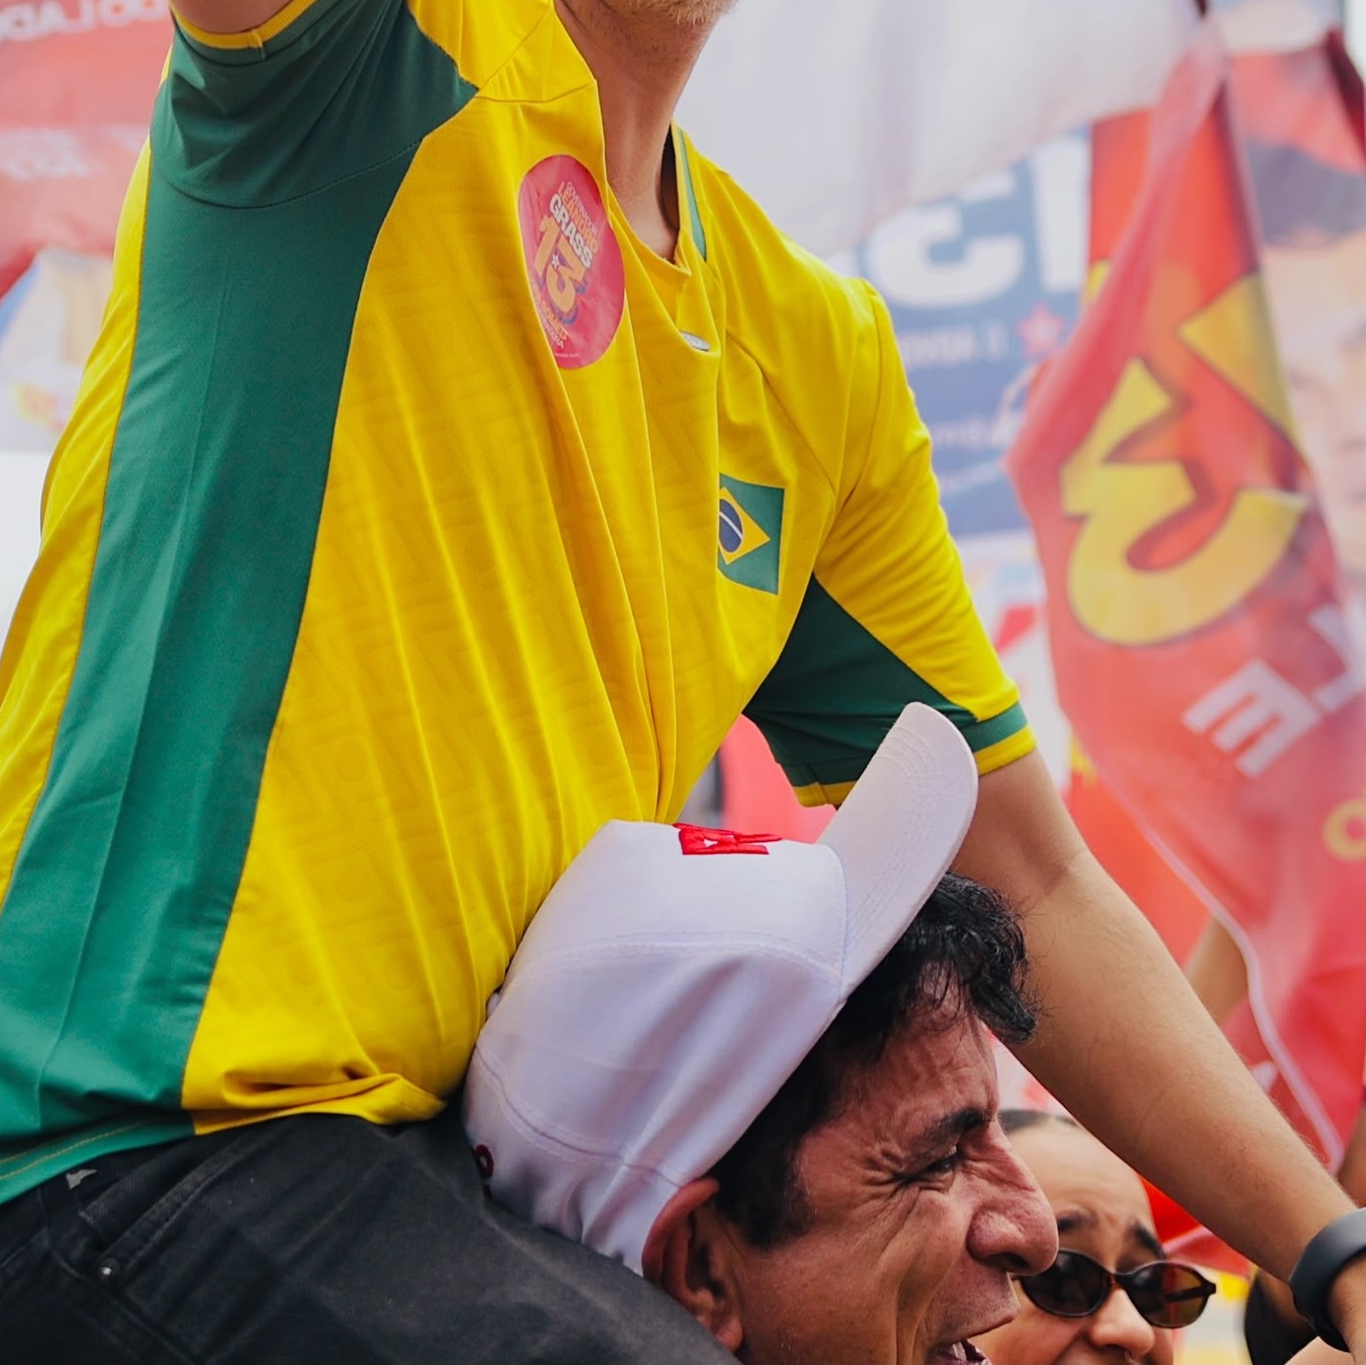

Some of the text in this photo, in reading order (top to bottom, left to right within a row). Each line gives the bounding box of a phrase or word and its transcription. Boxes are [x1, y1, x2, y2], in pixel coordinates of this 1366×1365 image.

[548, 193, 594, 269] GRASS
[557, 180, 599, 255] LEANDRO
[533, 215, 588, 313] 13
